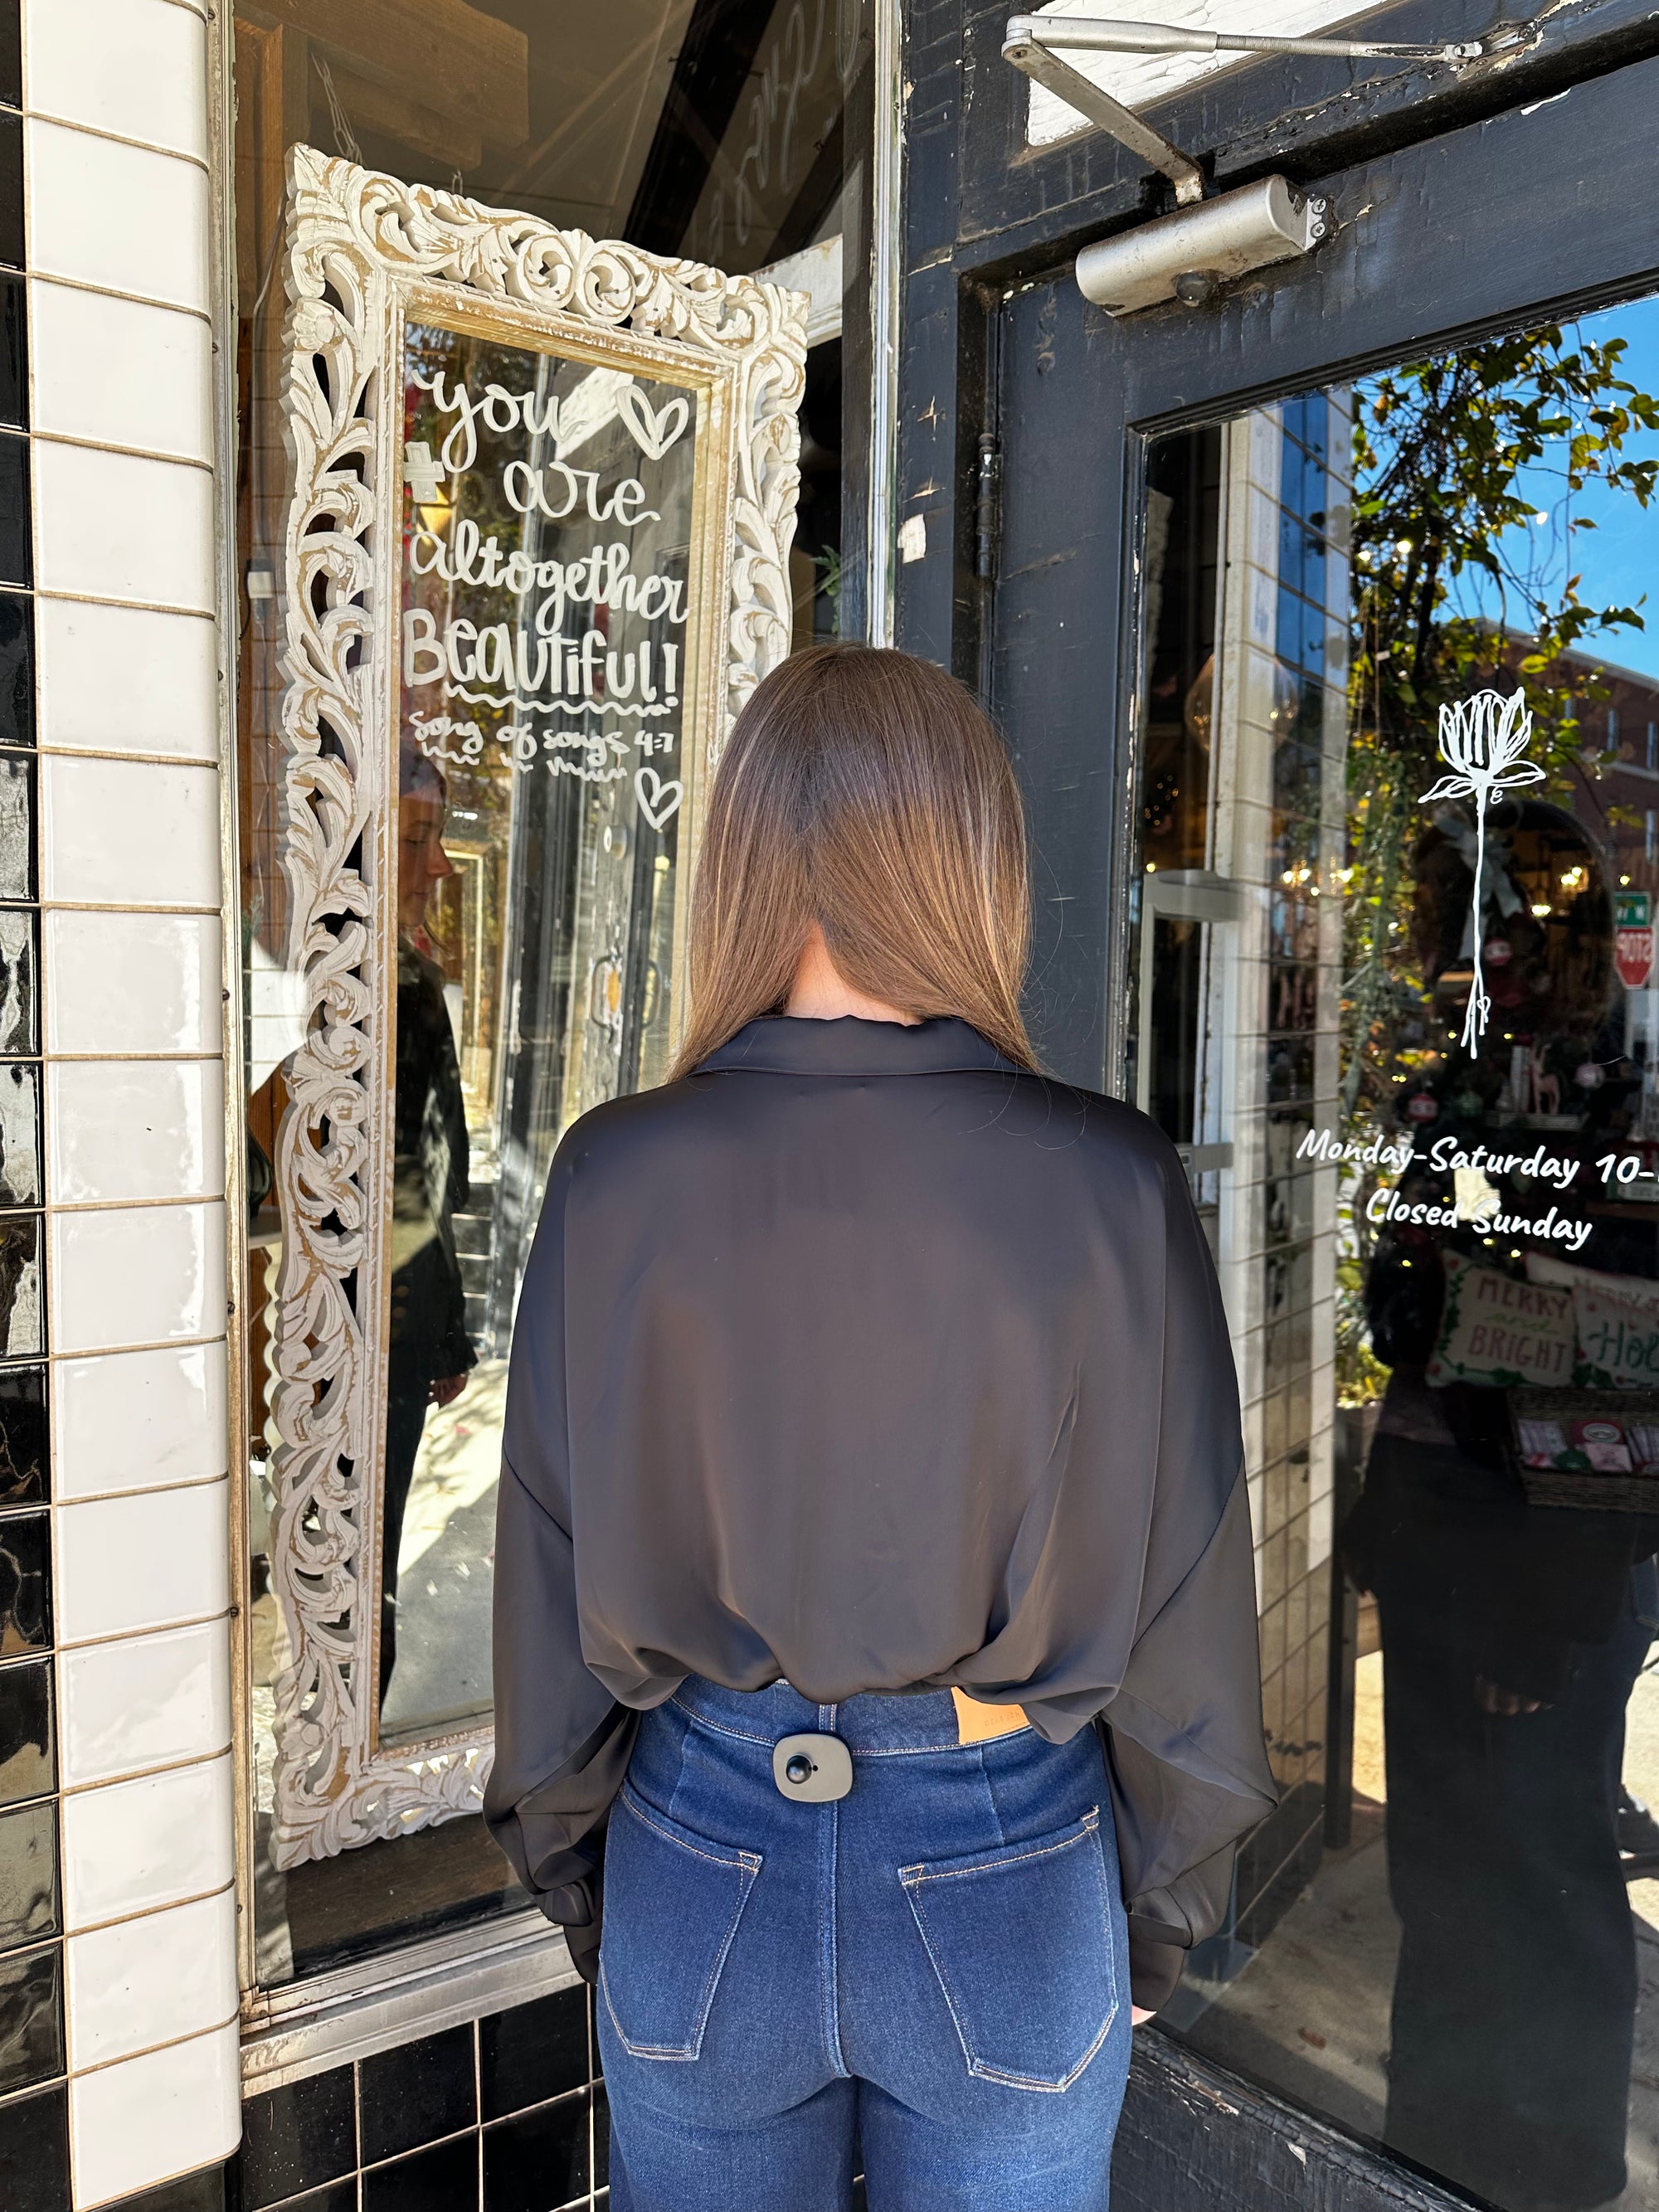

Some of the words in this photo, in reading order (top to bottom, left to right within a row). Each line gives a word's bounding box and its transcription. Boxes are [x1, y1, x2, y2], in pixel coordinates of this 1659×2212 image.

[412, 369, 586, 473] you
[504, 460, 661, 526] are
[410, 518, 690, 635] altogether
[496, 722, 538, 760] of
[1296, 1128, 1580, 1189] Monday-Saturday
[1595, 1153, 1659, 1184] 10-
[1366, 1187, 1462, 1229] Closed
[1472, 1198, 1593, 1251] Sunday
[1478, 1276, 1568, 1320] MERRY
[1468, 1325, 1568, 1373] BRIGHT
[1006, 1710, 1023, 1721] JOH
